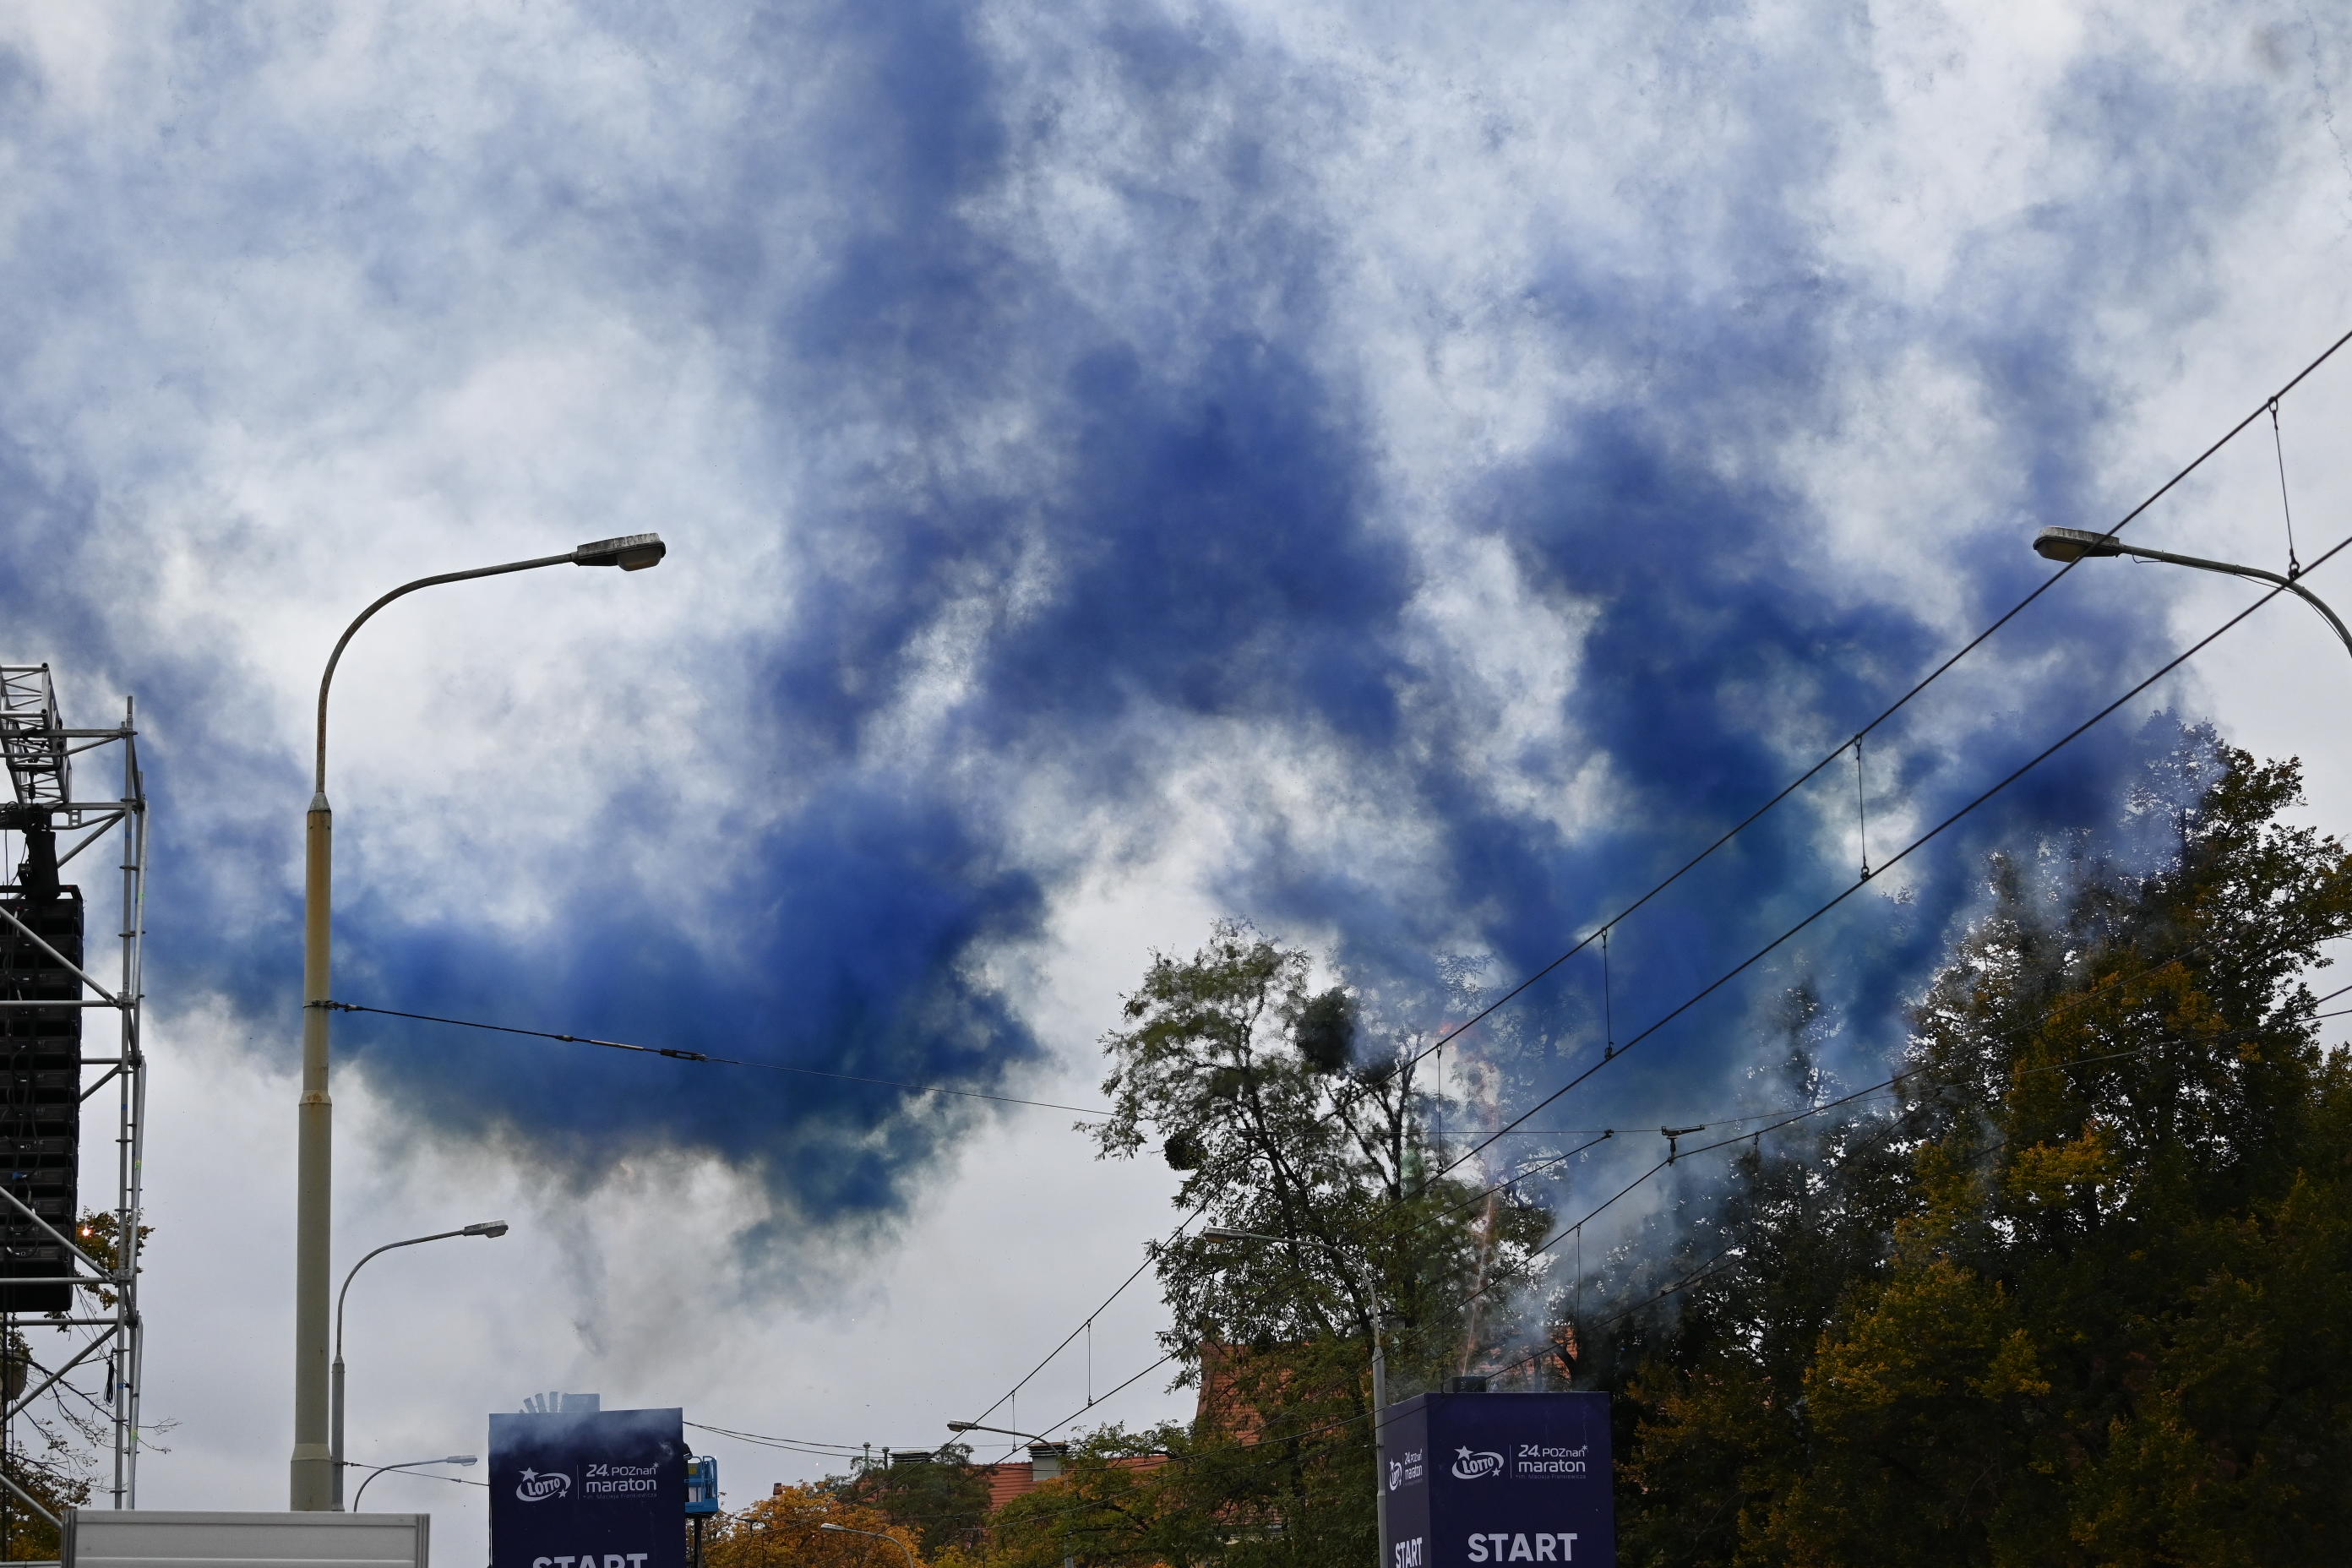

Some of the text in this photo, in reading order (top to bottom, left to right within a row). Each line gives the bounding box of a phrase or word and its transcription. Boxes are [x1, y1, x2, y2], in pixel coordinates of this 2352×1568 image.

[1518, 1444, 1541, 1457] 24.
[585, 1463, 610, 1478] 24.
[1462, 1456, 1494, 1474] LOTTO
[1518, 1459, 1586, 1473] maraton
[526, 1478, 561, 1497] LOTTO
[585, 1478, 657, 1493] maraton
[1396, 1537, 1423, 1568] START
[1467, 1533, 1578, 1563] START
